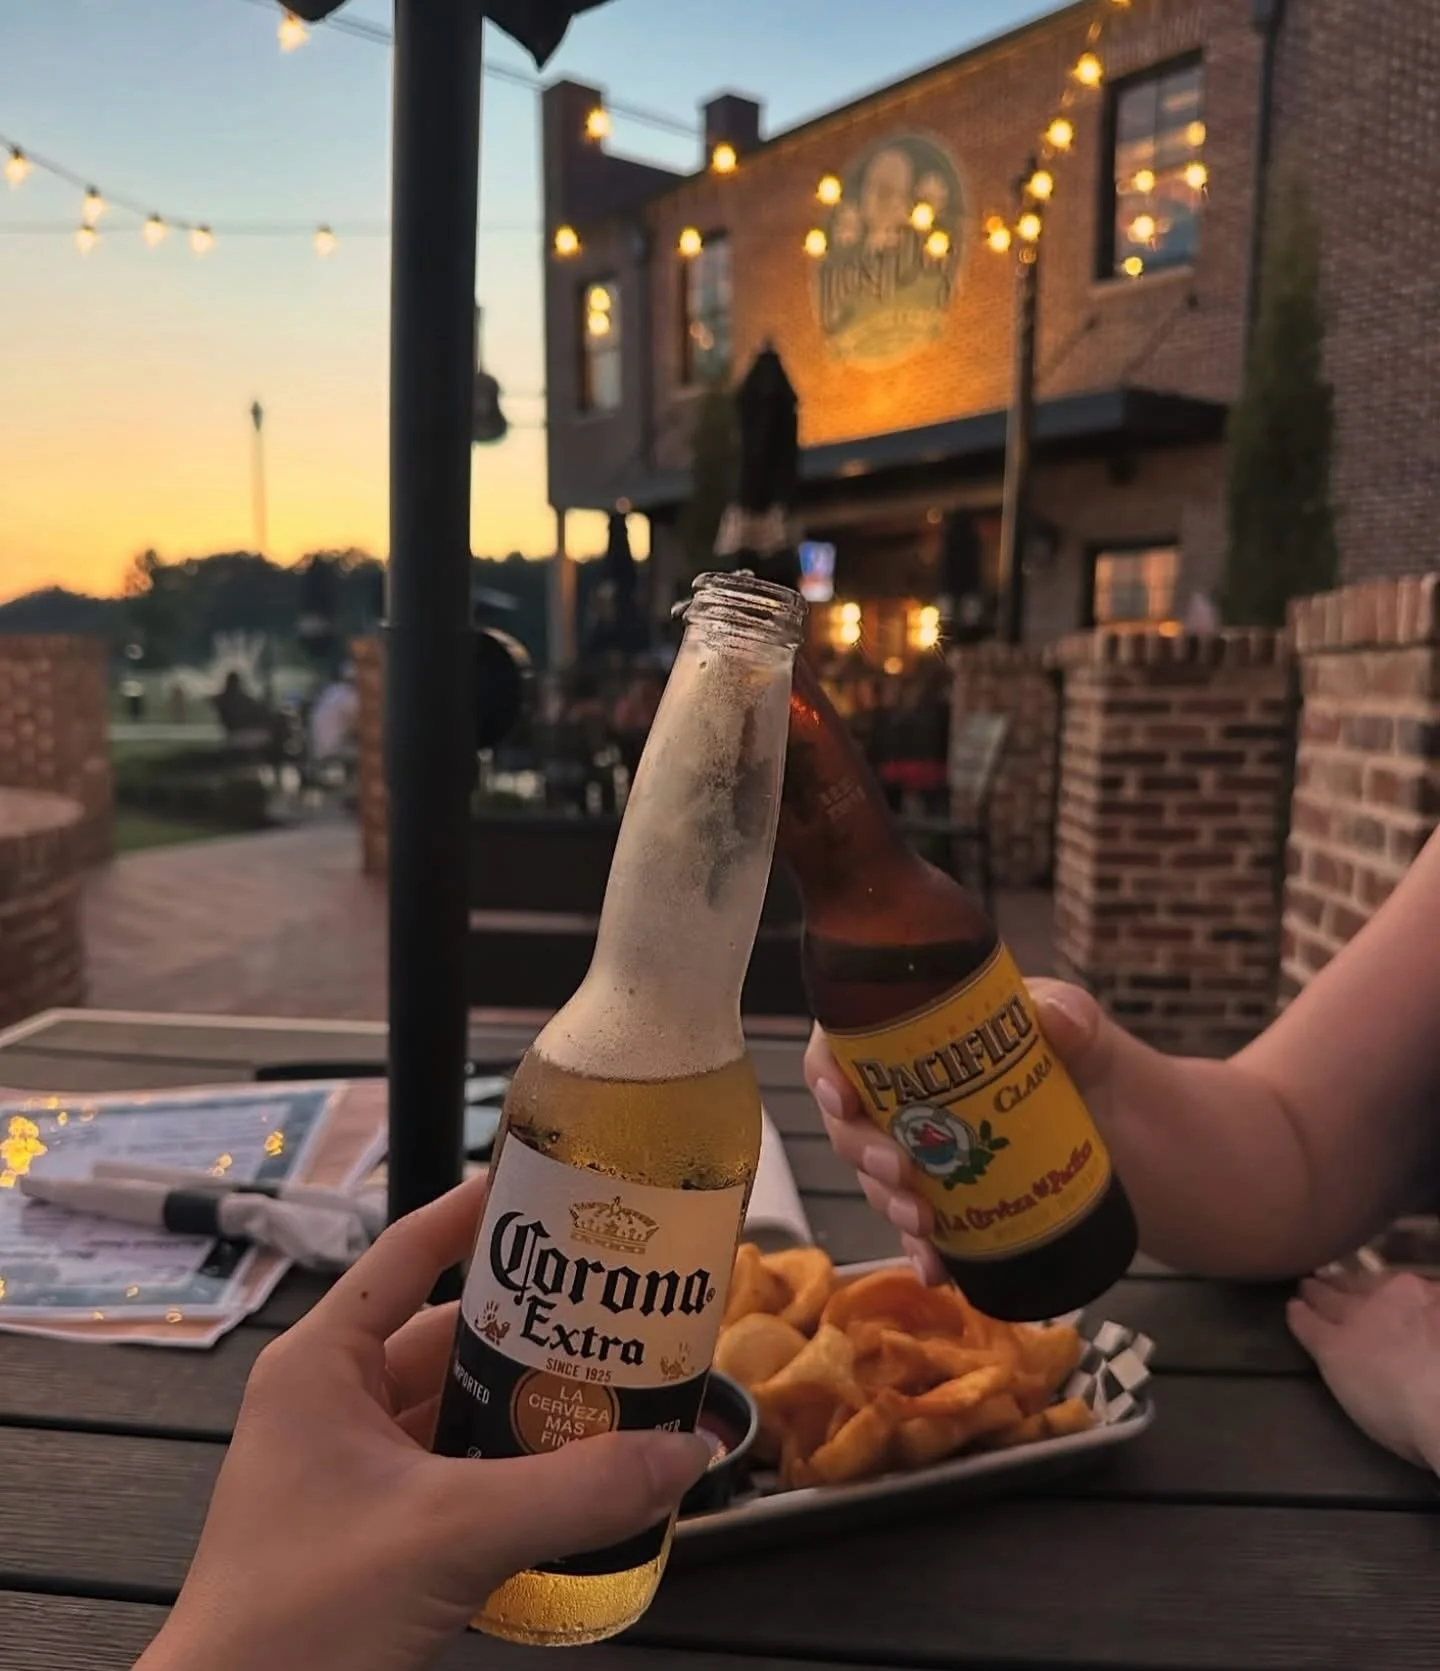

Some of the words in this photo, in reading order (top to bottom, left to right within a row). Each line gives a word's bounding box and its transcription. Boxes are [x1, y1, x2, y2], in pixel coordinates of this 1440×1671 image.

[852, 996, 1033, 1111] PACIFICO
[490, 1211, 711, 1317] Corona
[519, 1294, 645, 1365] Extra
[453, 1360, 490, 1404] MPORTED
[546, 1357, 579, 1378] SINCE
[585, 1367, 612, 1382] 1925
[528, 1393, 610, 1424] CERVEZA
[559, 1386, 583, 1403] LA
[541, 1431, 580, 1448] FIN
[545, 1415, 585, 1435] MAS
